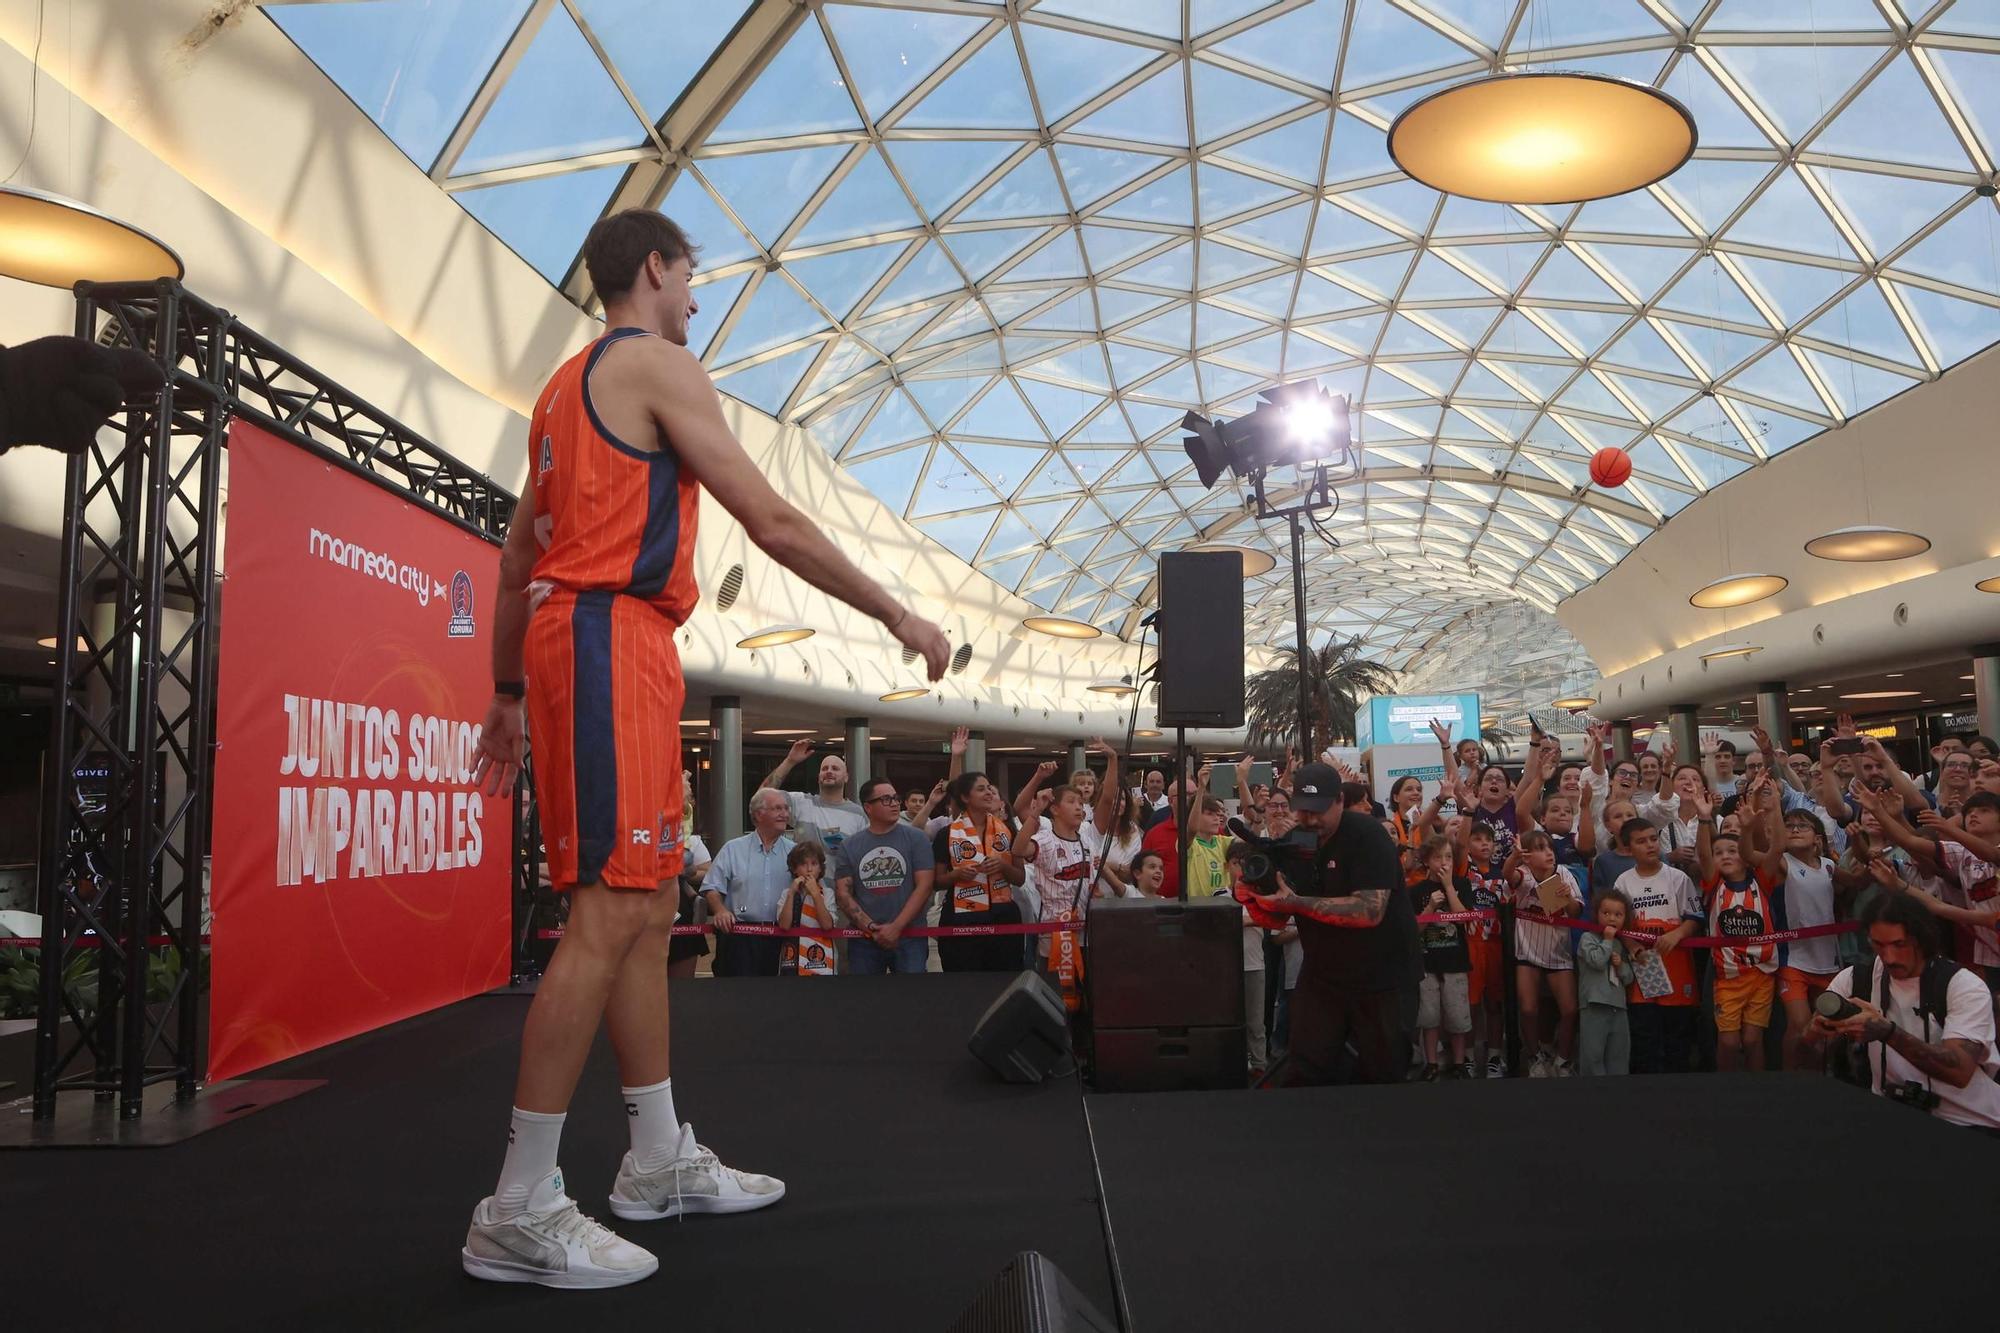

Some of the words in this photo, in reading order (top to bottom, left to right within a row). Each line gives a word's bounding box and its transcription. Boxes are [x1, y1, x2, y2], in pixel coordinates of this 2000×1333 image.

[310, 527, 397, 584] marineda
[400, 565, 429, 606] city
[280, 693, 400, 780] JUNTOS
[277, 786, 483, 887] IMPARABLES
[1211, 872, 1222, 888] 10
[1633, 893, 1665, 902] BASQUET
[1058, 910, 1073, 980] Fixeno
[1724, 915, 1758, 926] Estrella
